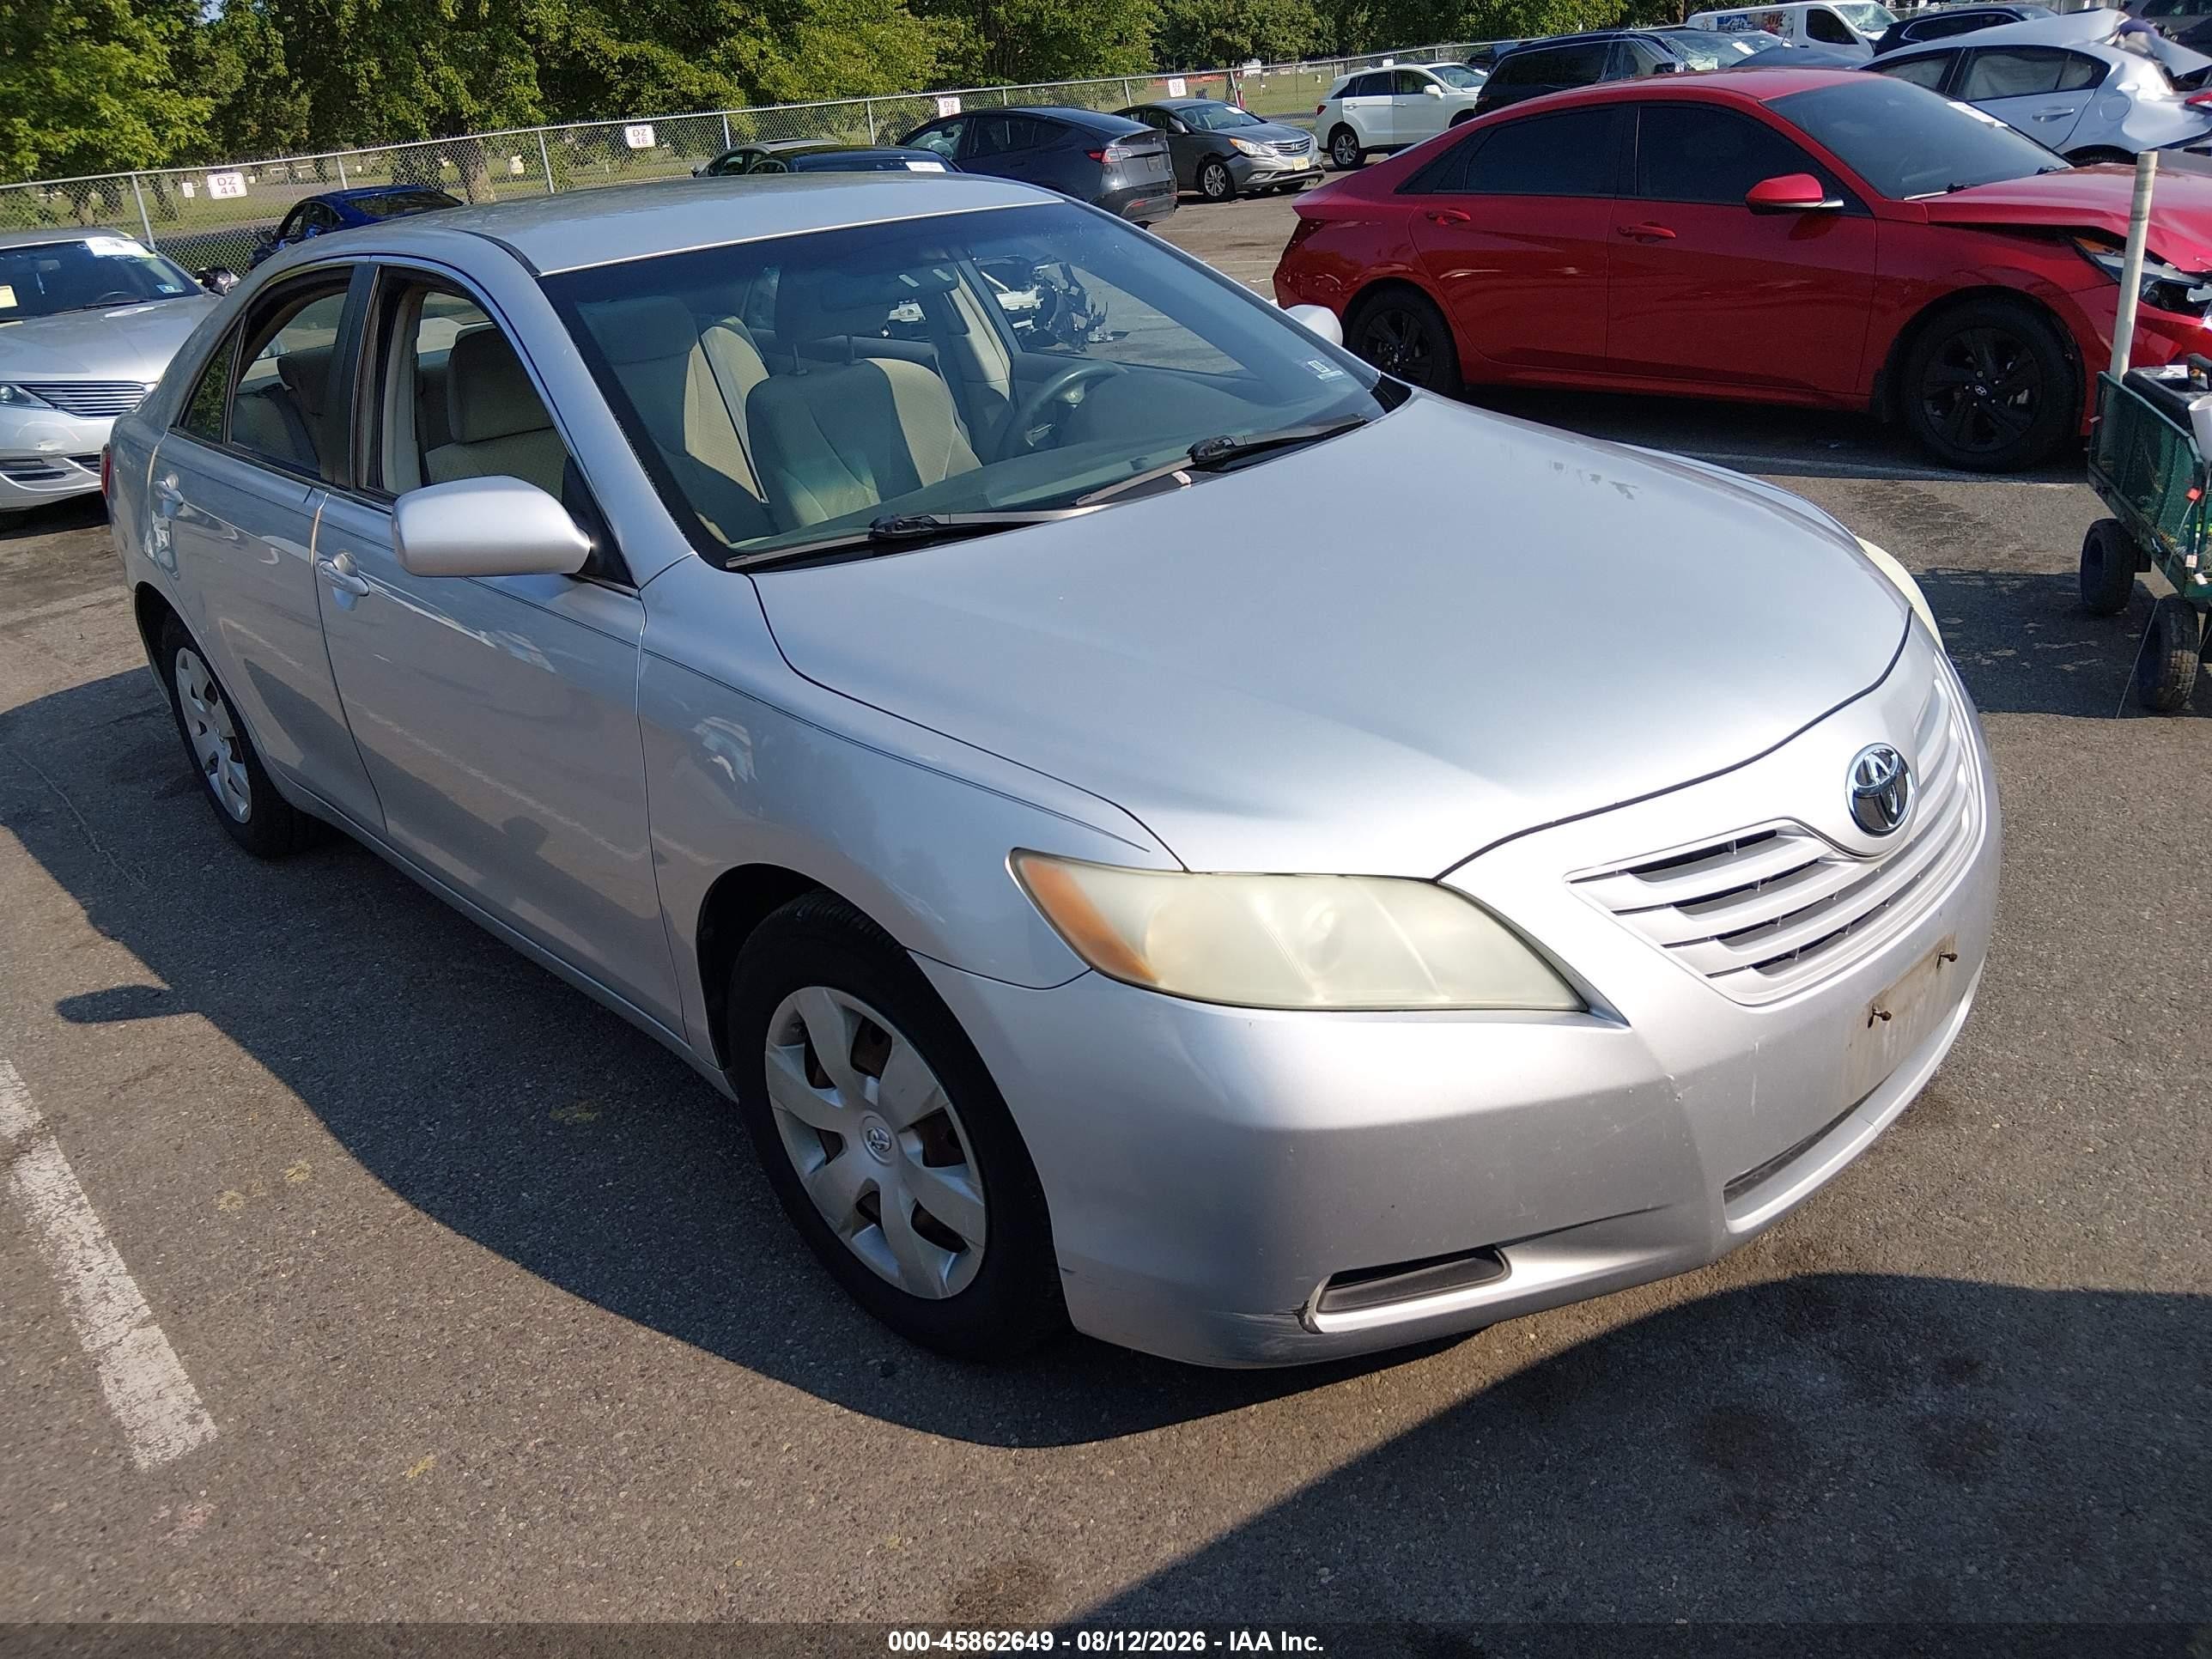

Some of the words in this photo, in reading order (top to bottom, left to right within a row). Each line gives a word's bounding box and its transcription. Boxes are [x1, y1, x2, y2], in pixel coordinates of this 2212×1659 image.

[632, 129, 647, 137] DZ
[217, 177, 236, 186] DZ
[221, 185, 237, 194] 44
